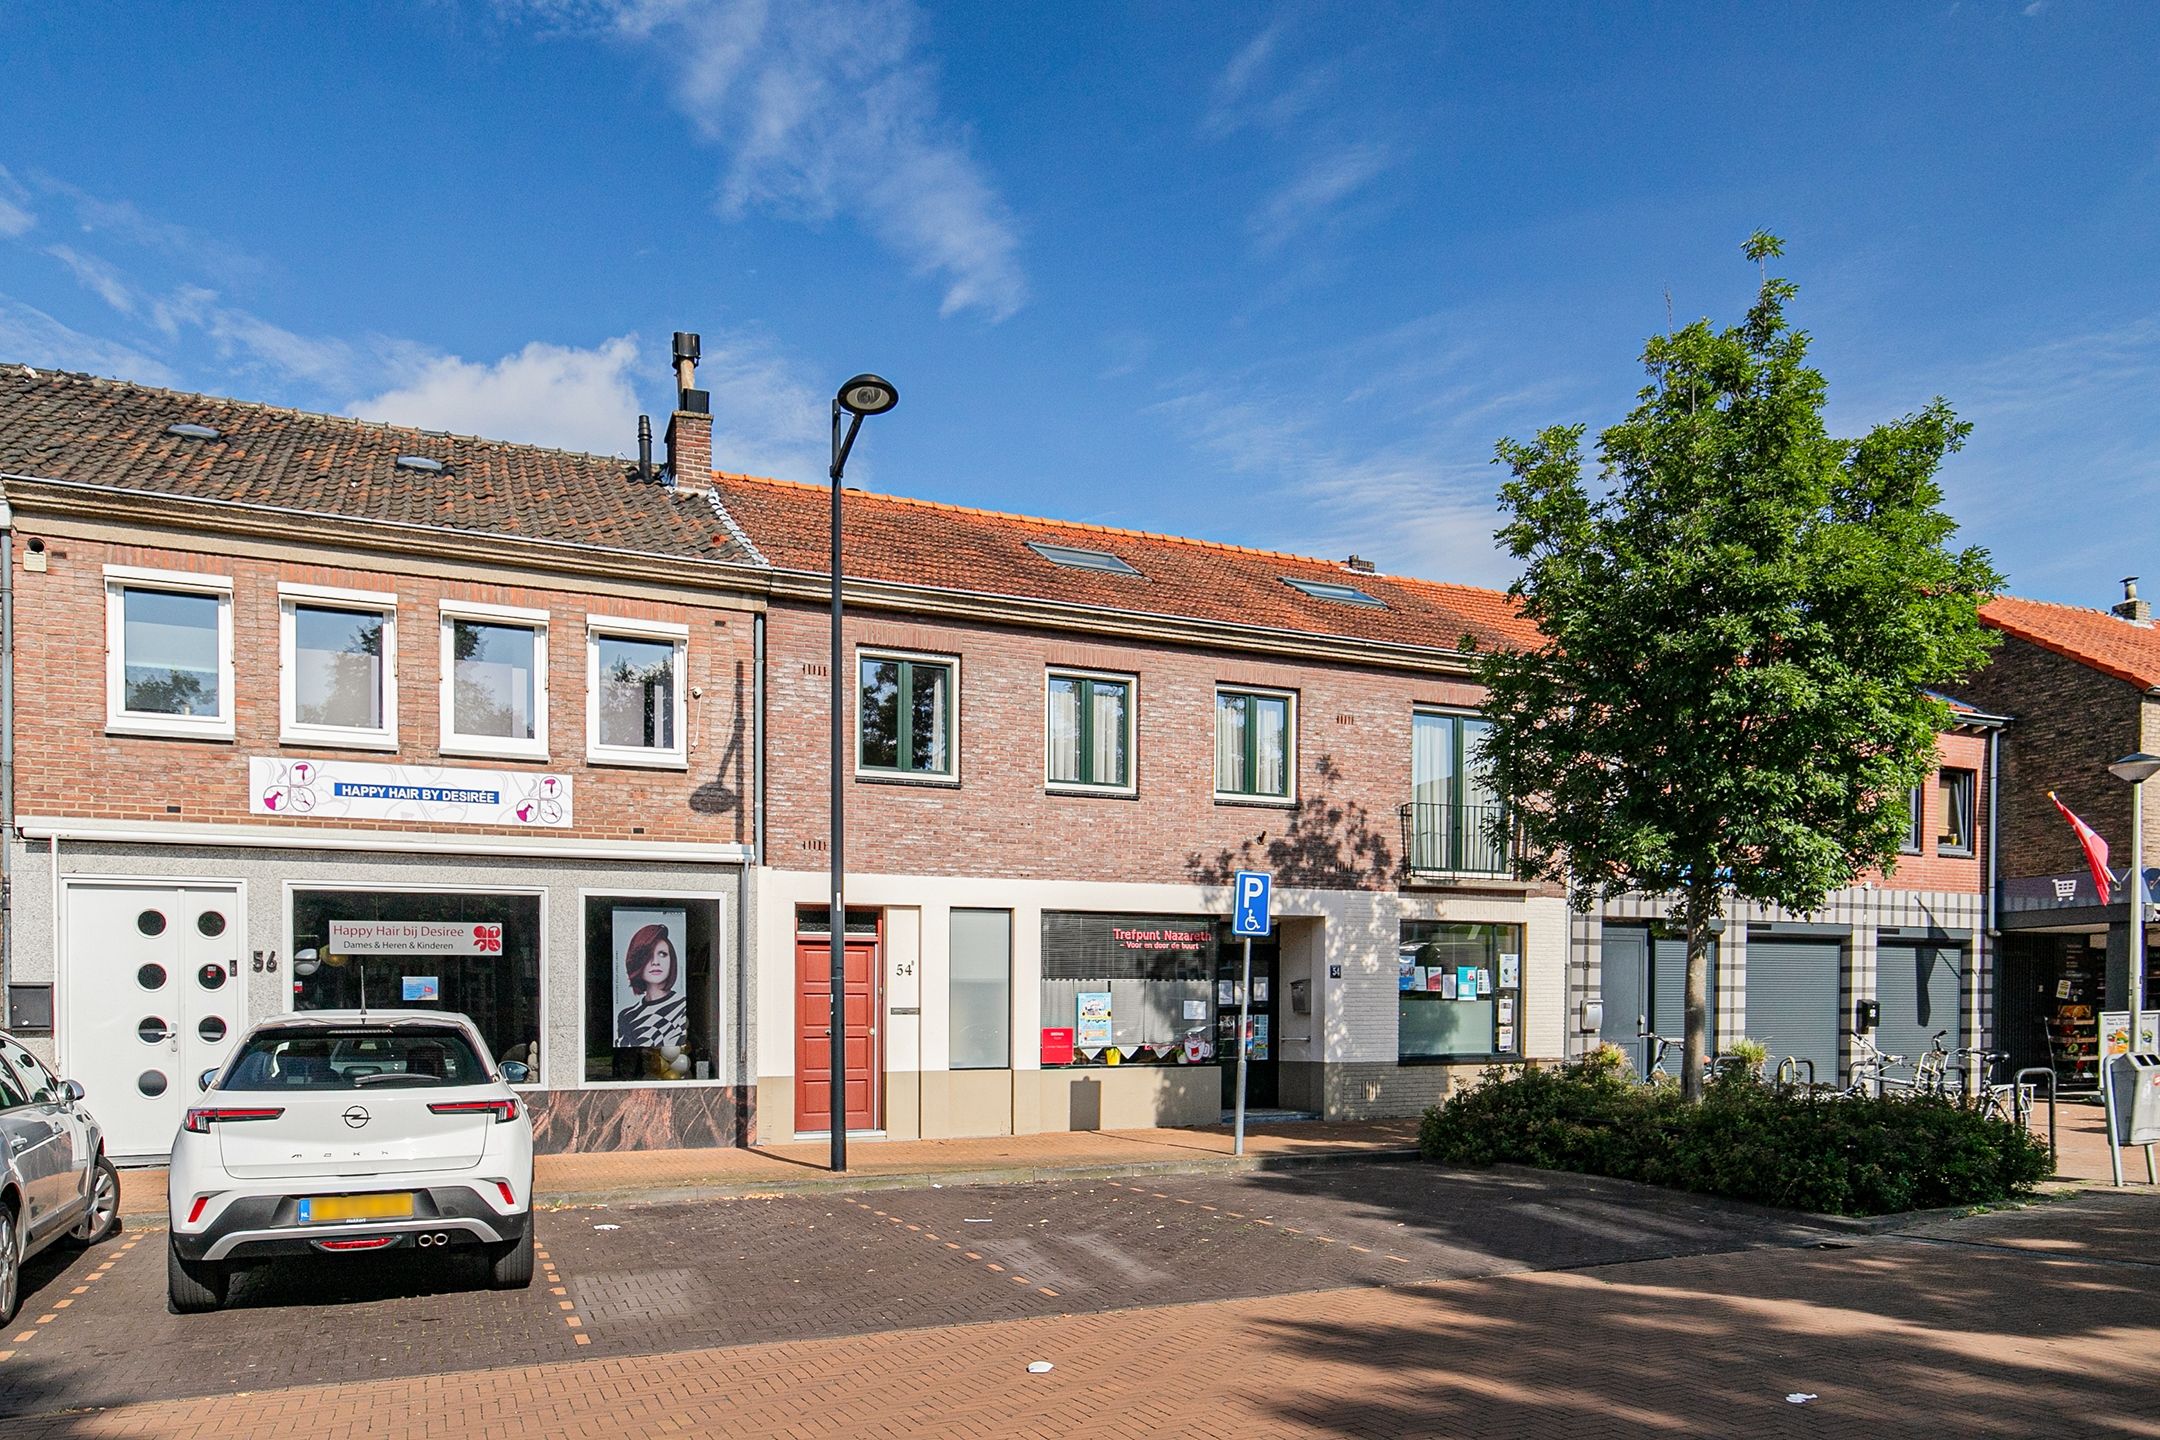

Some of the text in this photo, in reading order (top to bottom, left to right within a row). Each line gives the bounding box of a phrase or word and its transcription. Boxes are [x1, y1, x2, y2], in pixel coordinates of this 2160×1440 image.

[342, 784, 495, 804] HAPPY HAIR BY DESIRÉE
[1243, 877, 1263, 908] P
[333, 925, 464, 939] Happy Hair bij Desiree
[1113, 928, 1211, 942] Trefpunt Nazareth
[343, 940, 453, 950] Dames & Heren & Kinderen
[1126, 941, 1142, 949] Voor
[1154, 941, 1170, 949] door
[252, 950, 277, 973] 56
